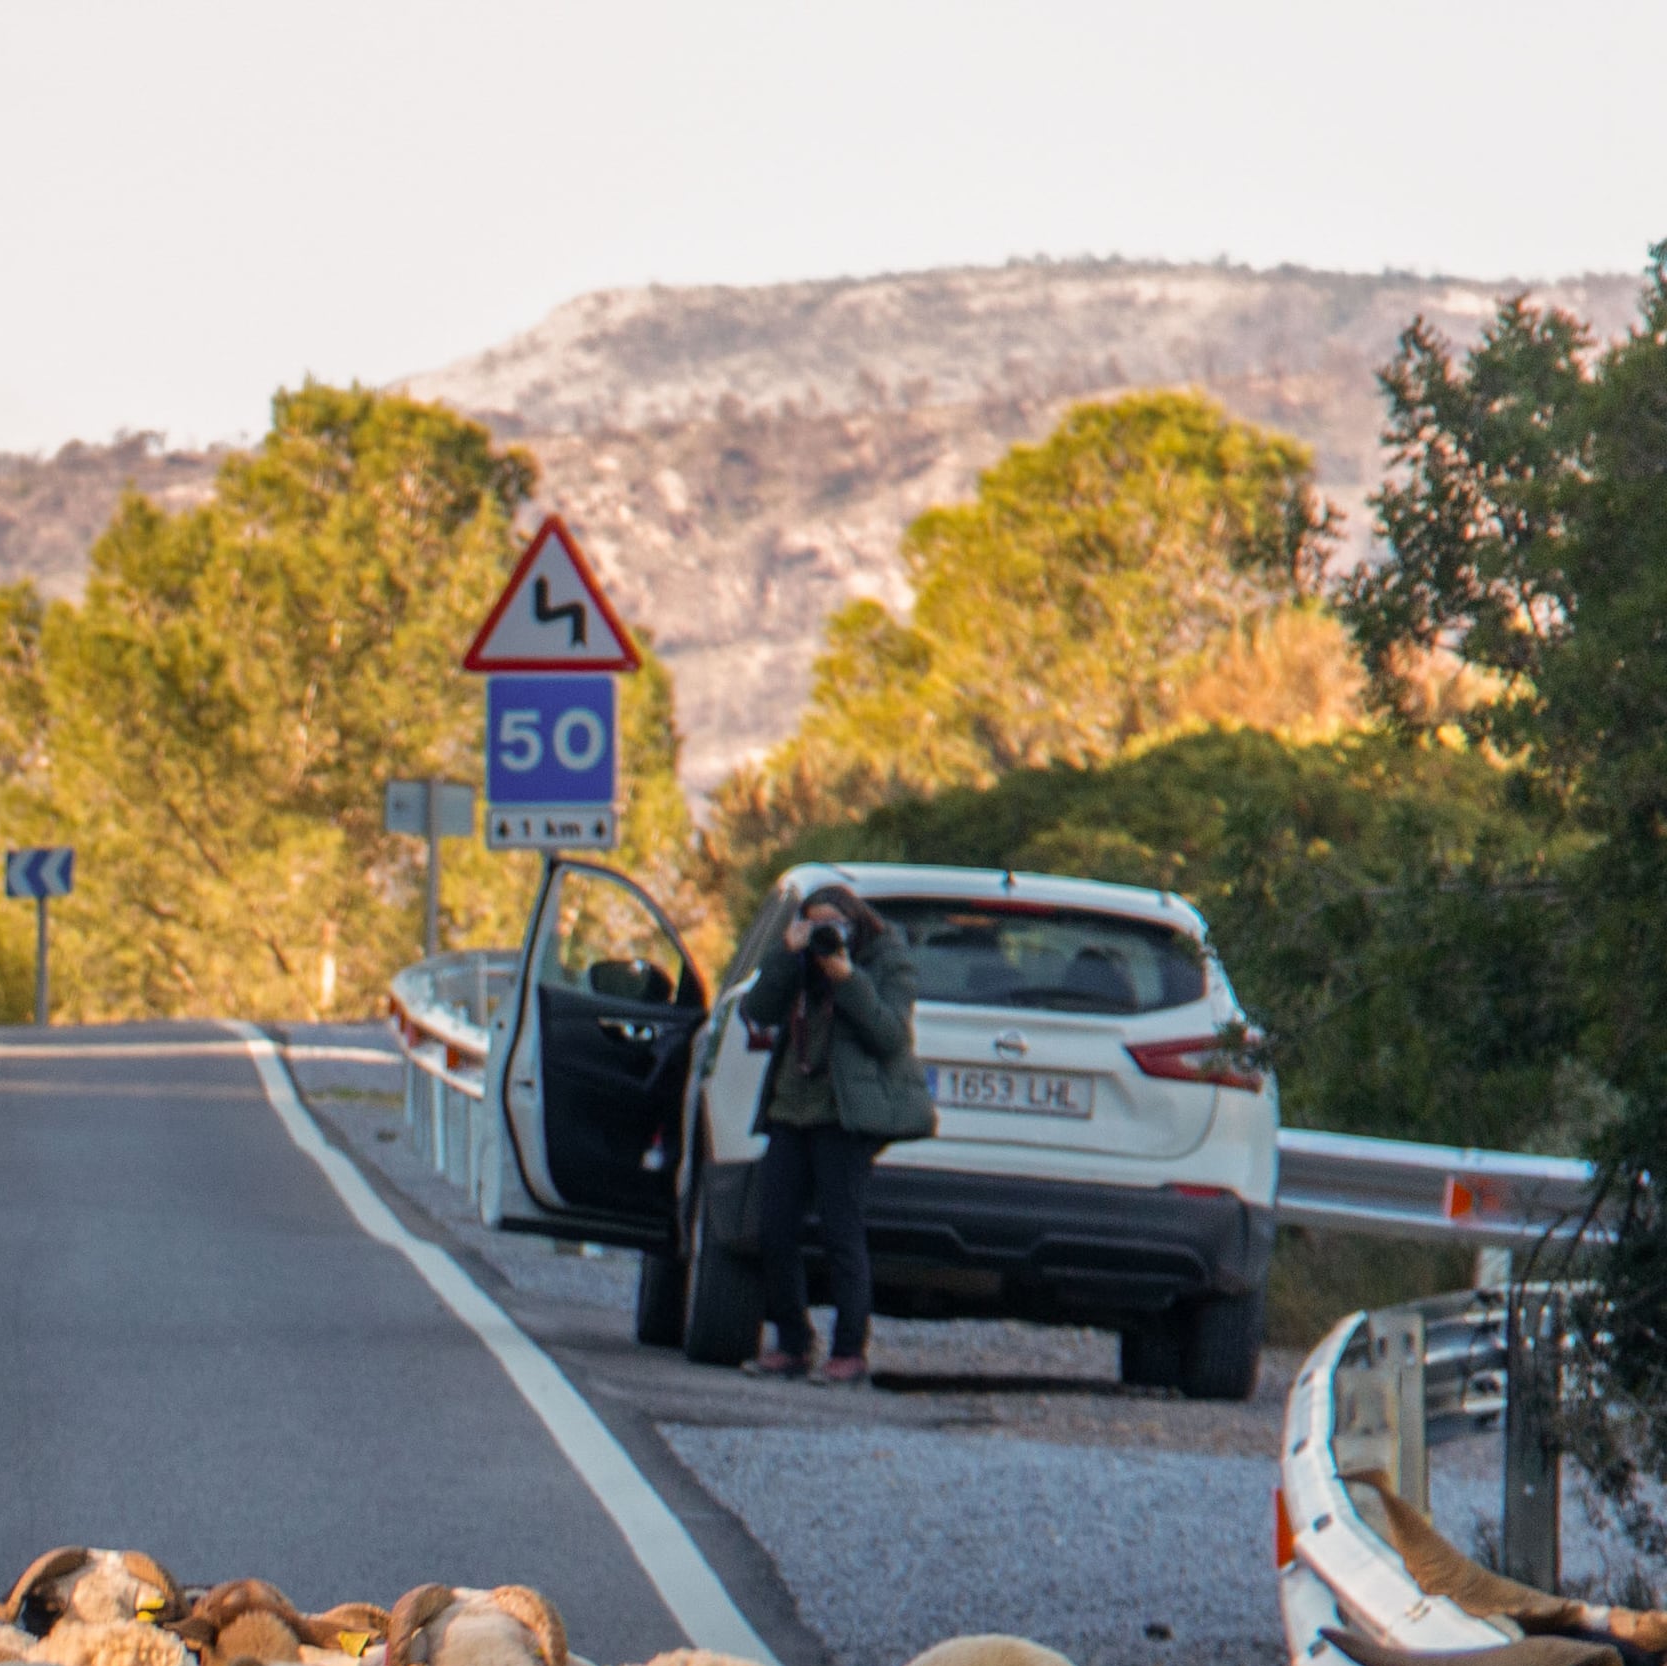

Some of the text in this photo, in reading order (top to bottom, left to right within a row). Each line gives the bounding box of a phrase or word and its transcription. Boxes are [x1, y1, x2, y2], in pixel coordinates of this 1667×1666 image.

[499, 708, 606, 772] 50
[521, 816, 582, 837] 1 km
[951, 1070, 1079, 1109] 1653 LHL
